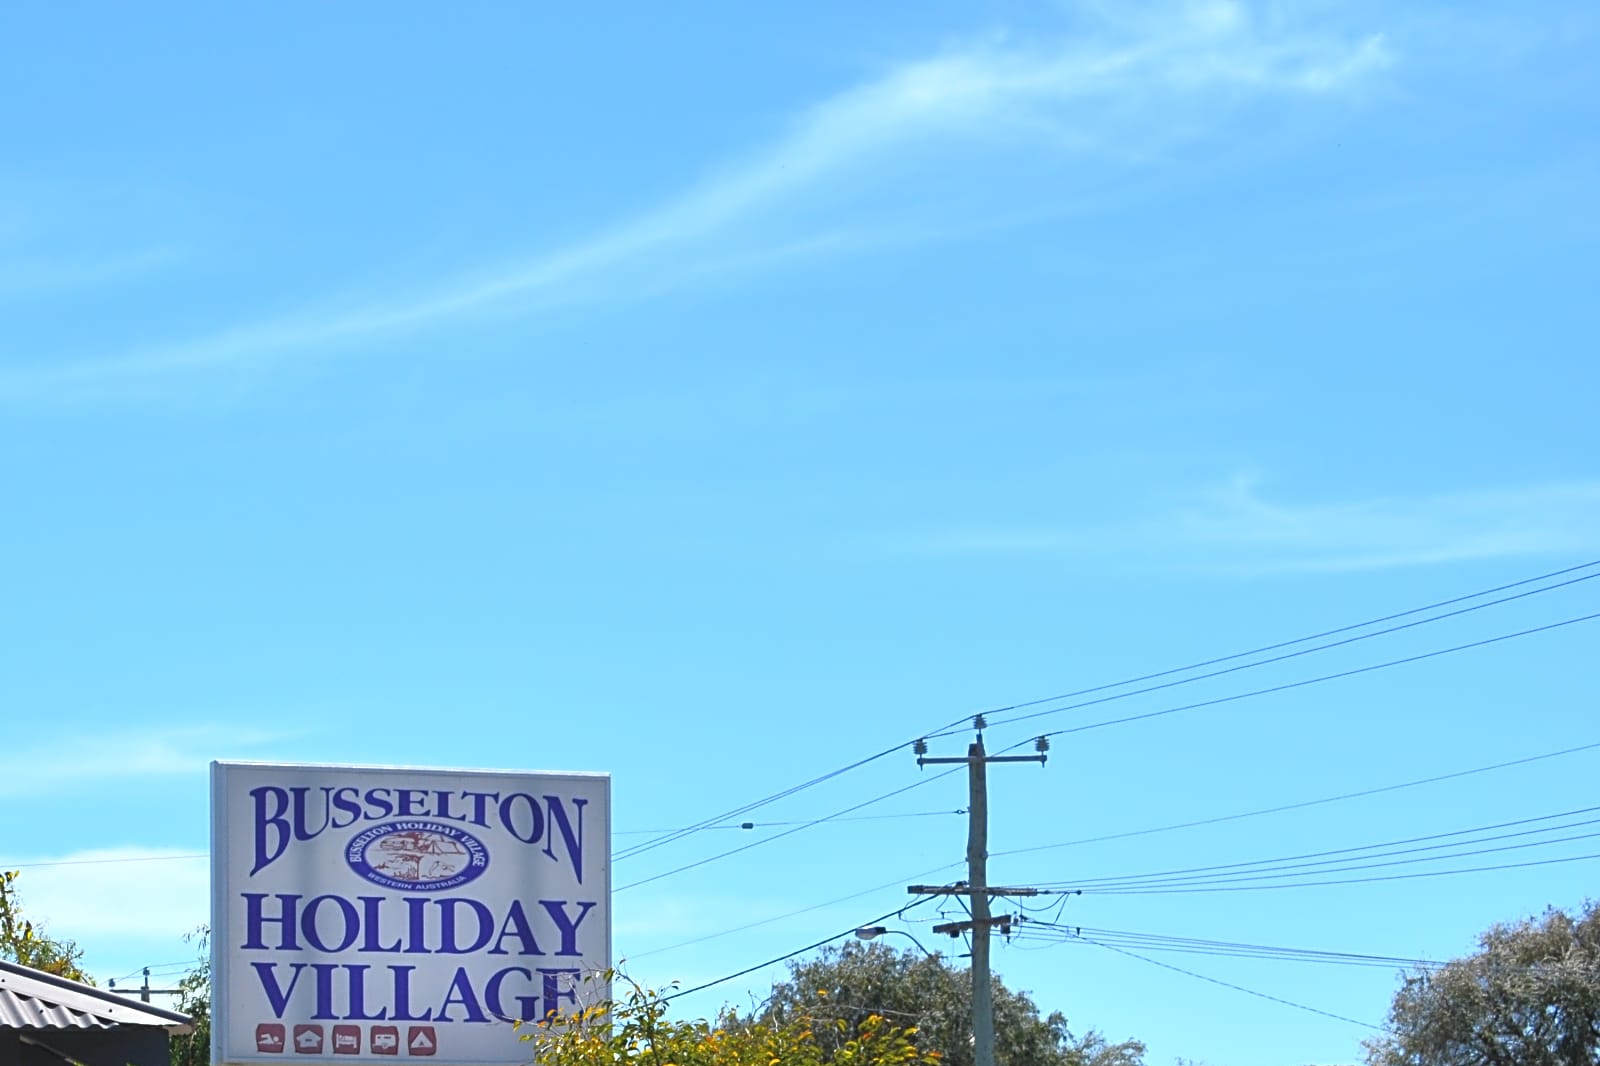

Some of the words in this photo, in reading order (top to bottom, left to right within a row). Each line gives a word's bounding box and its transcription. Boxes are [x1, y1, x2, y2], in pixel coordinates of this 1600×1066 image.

[249, 785, 589, 886] BUSSELTON
[349, 824, 393, 863] BUSSELTON
[396, 821, 461, 837] HOLIDAY
[460, 835, 486, 867] VILLAGE
[367, 872, 413, 889] WESTERN
[415, 875, 467, 890] AUSTRALIA
[240, 892, 597, 957] HOLIDAY
[250, 961, 585, 1024] VILLAGE
